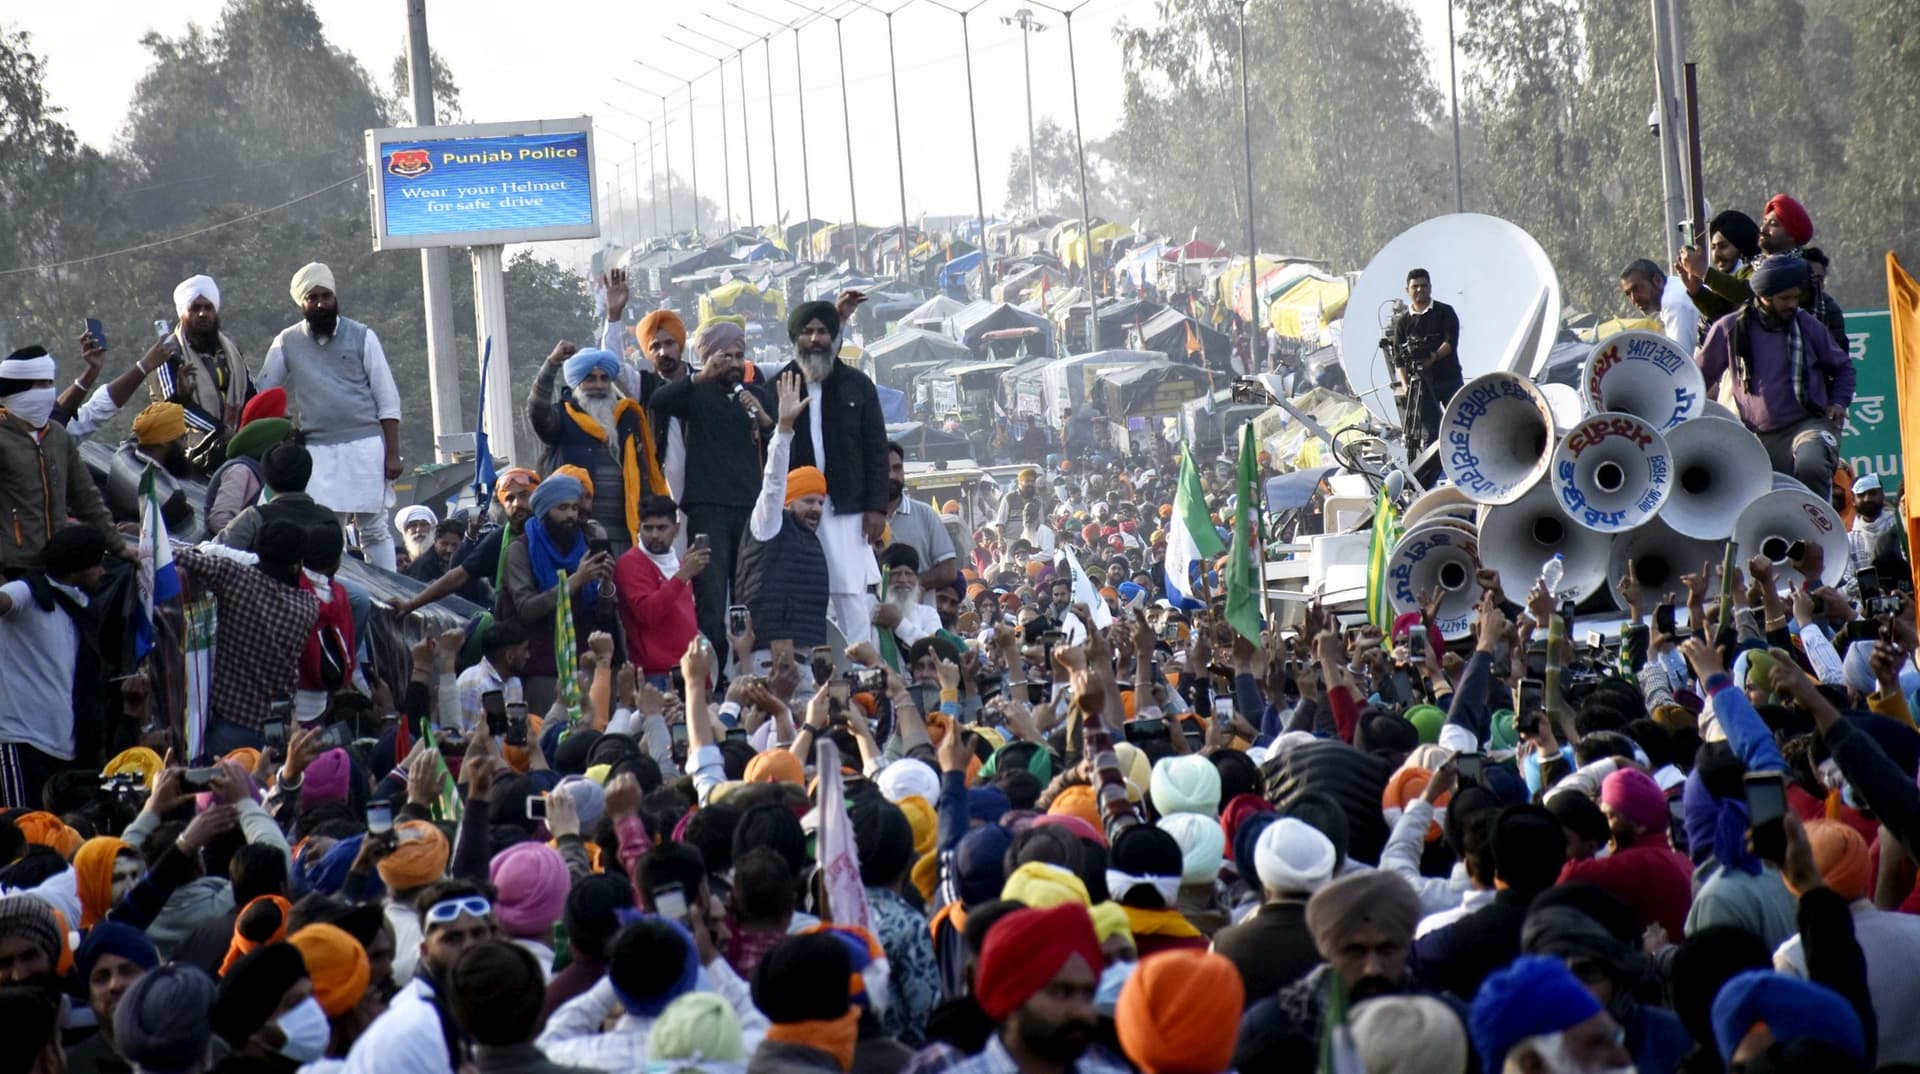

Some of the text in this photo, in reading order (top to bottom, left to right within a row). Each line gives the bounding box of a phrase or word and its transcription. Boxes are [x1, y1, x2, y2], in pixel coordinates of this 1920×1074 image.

[443, 147, 578, 165] Punjab Police
[401, 180, 568, 199] Wear your Helmet
[427, 197, 544, 213] for safe drive
